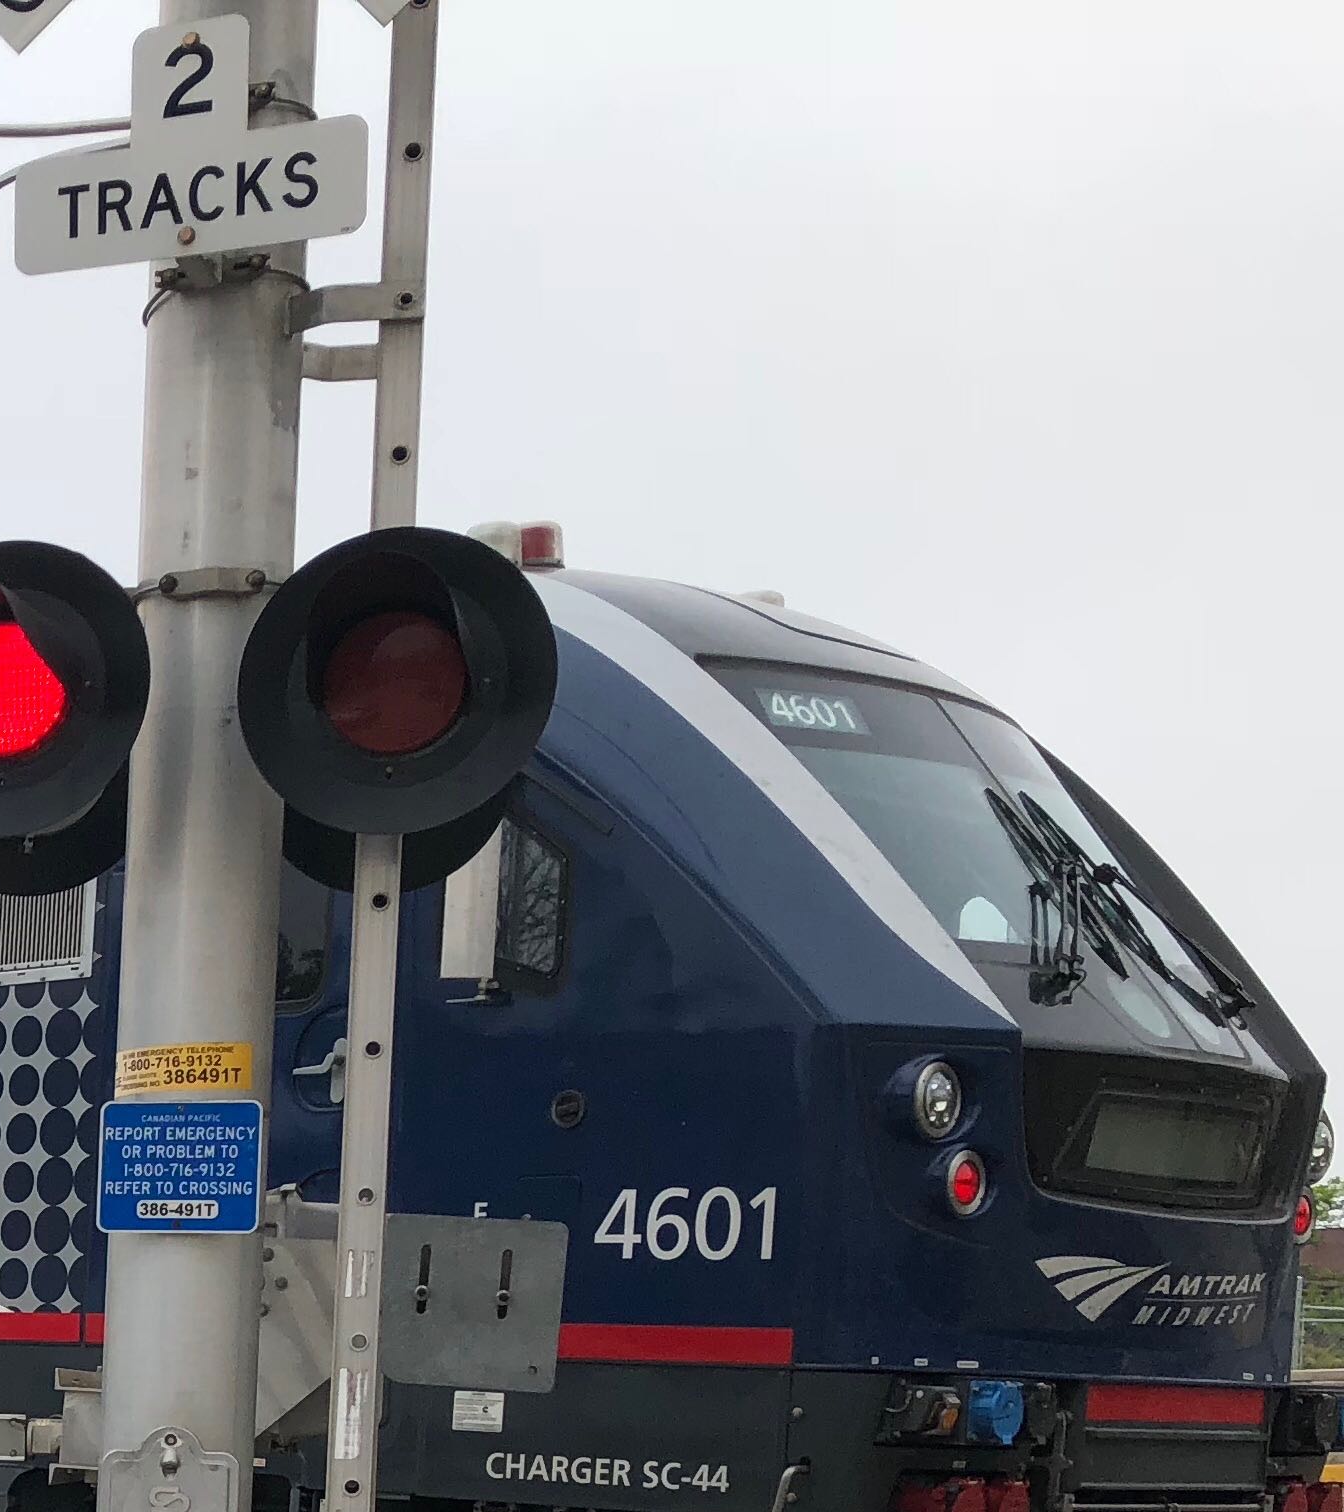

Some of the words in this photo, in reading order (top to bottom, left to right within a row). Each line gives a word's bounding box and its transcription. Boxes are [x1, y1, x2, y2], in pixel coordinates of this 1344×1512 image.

[163, 43, 214, 118] 2
[58, 151, 319, 239] TRACKS
[771, 692, 856, 730] 4601
[137, 1047, 184, 1058] EMERGENCY
[186, 1046, 234, 1054] TELEPHONE
[123, 1054, 222, 1073] 1-800-716-9132
[163, 1067, 242, 1084] 386491T
[141, 1114, 186, 1122] CANADIAN
[188, 1113, 221, 1122] PACIFIC
[105, 1127, 161, 1140] REPORT
[166, 1127, 256, 1140] EMERGENCY
[122, 1145, 141, 1158] OR
[147, 1145, 214, 1158] PROBLEM
[221, 1145, 238, 1158] TO
[124, 1163, 235, 1177] 1-800-716-9132
[105, 1181, 150, 1195] REFER
[156, 1181, 173, 1195] TO
[179, 1181, 253, 1195] CROSSING
[140, 1203, 215, 1217] 386-491T
[593, 1185, 777, 1261] 4601
[1148, 1272, 1267, 1296] AMTRAK
[1131, 1304, 1256, 1325] MIDWEST
[485, 1452, 631, 1487] CHARGER
[642, 1460, 730, 1493] SC-44
